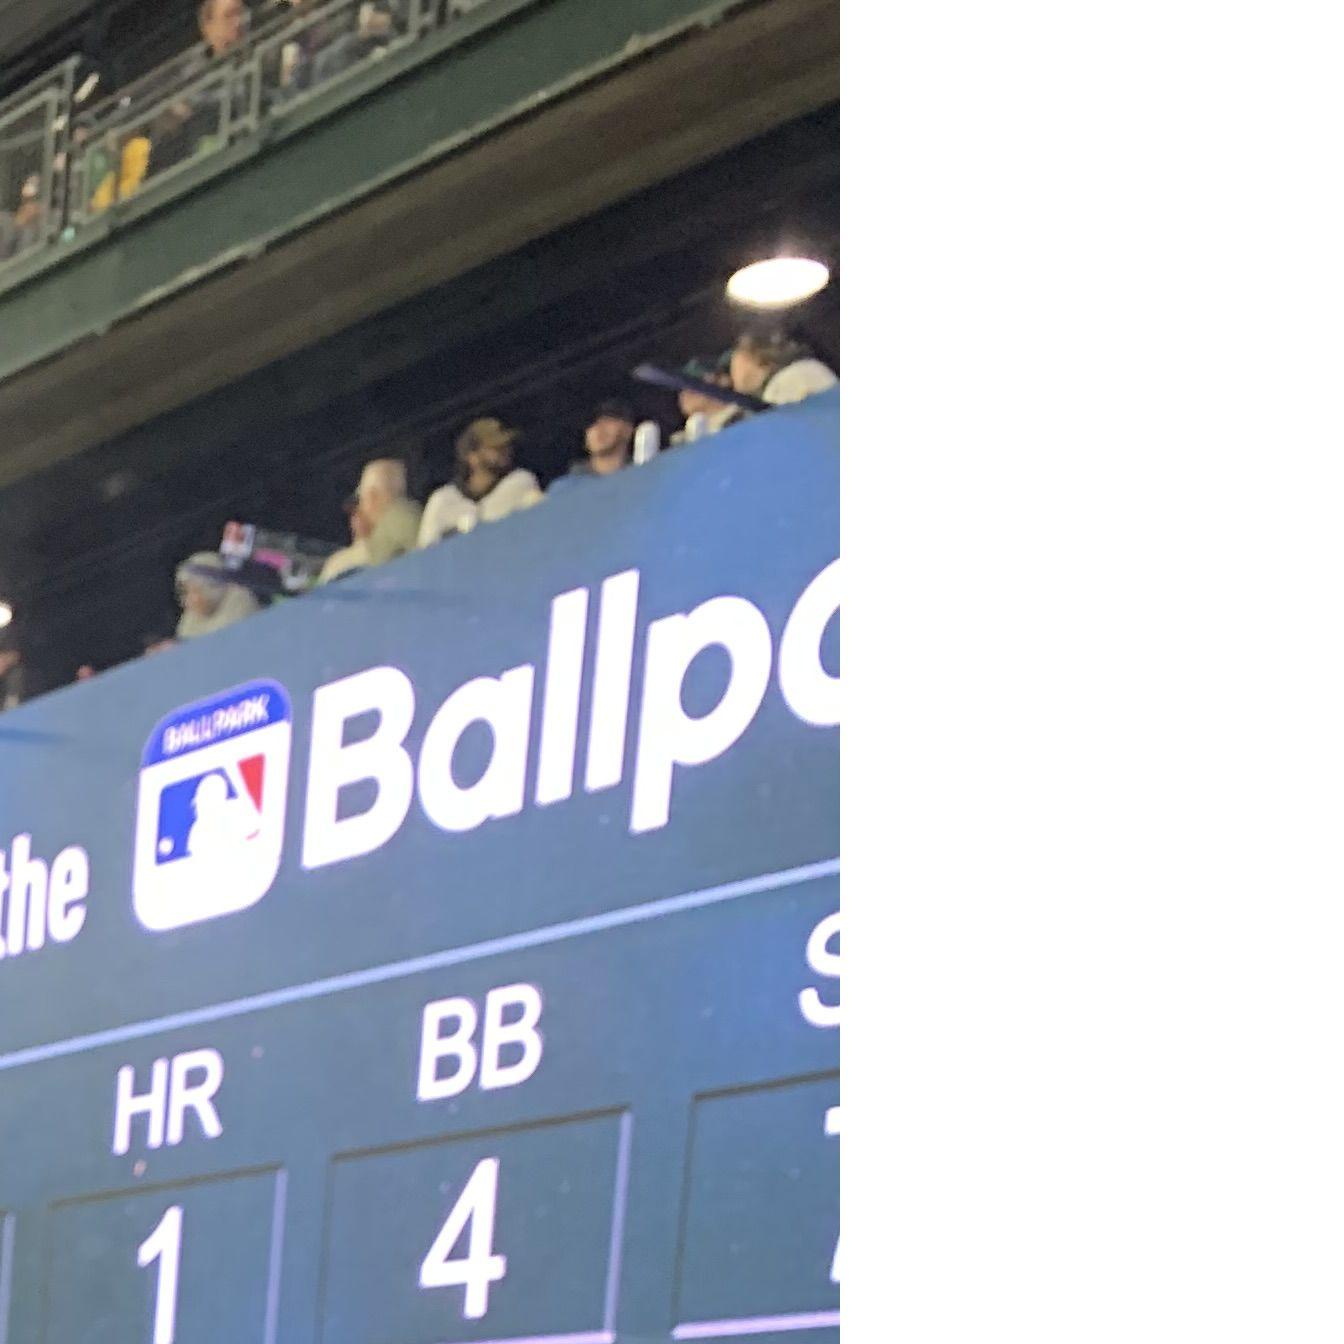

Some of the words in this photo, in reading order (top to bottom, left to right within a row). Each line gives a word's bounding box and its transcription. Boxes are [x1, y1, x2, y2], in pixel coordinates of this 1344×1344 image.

[112, 1048, 224, 1155] HR
[417, 983, 543, 1103] BB
[418, 1157, 507, 1319] 4
